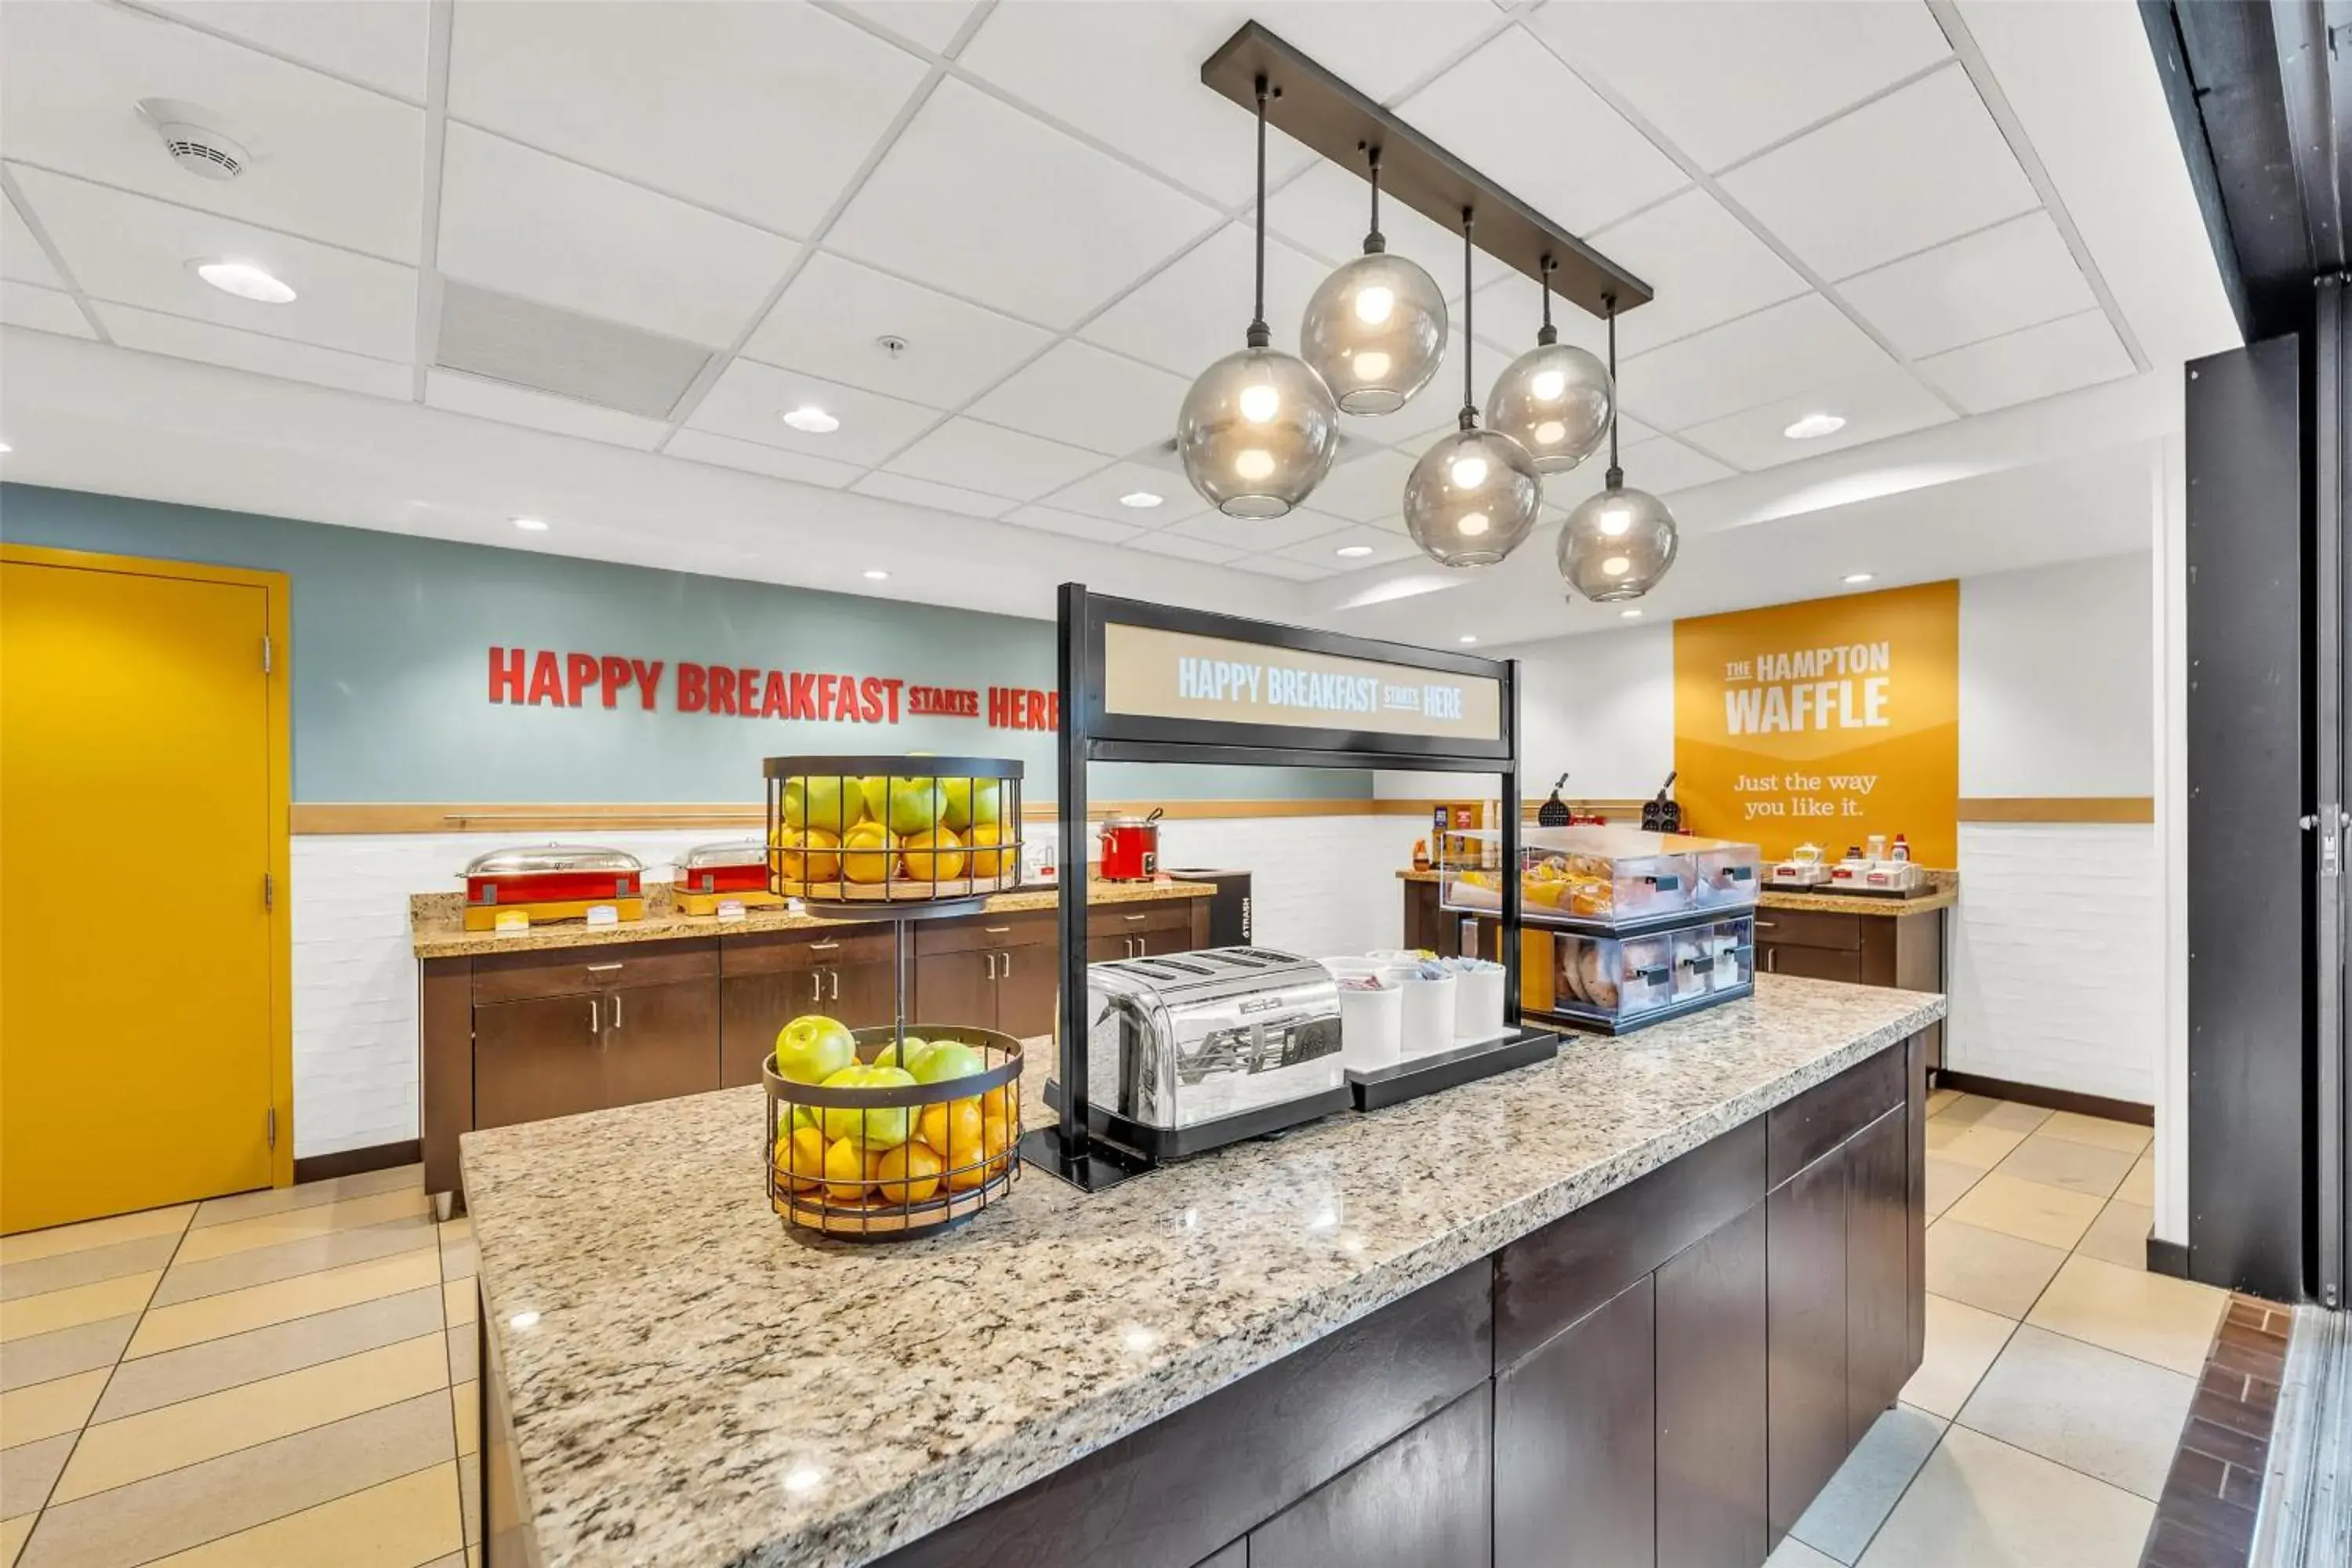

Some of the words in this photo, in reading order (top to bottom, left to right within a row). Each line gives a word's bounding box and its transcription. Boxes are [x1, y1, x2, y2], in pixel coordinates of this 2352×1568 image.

[1726, 661, 1752, 677] THE
[1757, 641, 1889, 682] HAMPTON
[488, 647, 664, 711] HAPPY
[677, 662, 903, 724] BREAKFAST
[909, 686, 978, 713] STARTS
[1178, 657, 1261, 703] HAPPY
[1268, 667, 1378, 713] BREAKFAST
[1424, 684, 1462, 720] HERE
[1726, 677, 1890, 735] WAFFLE
[1733, 774, 1778, 791] Just
[1784, 771, 1821, 791] the
[1827, 775, 1878, 796] way
[1745, 801, 1785, 821] you
[1791, 797, 1835, 816] like
[1841, 797, 1864, 816] it.
[1242, 897, 1250, 931] TRASH
